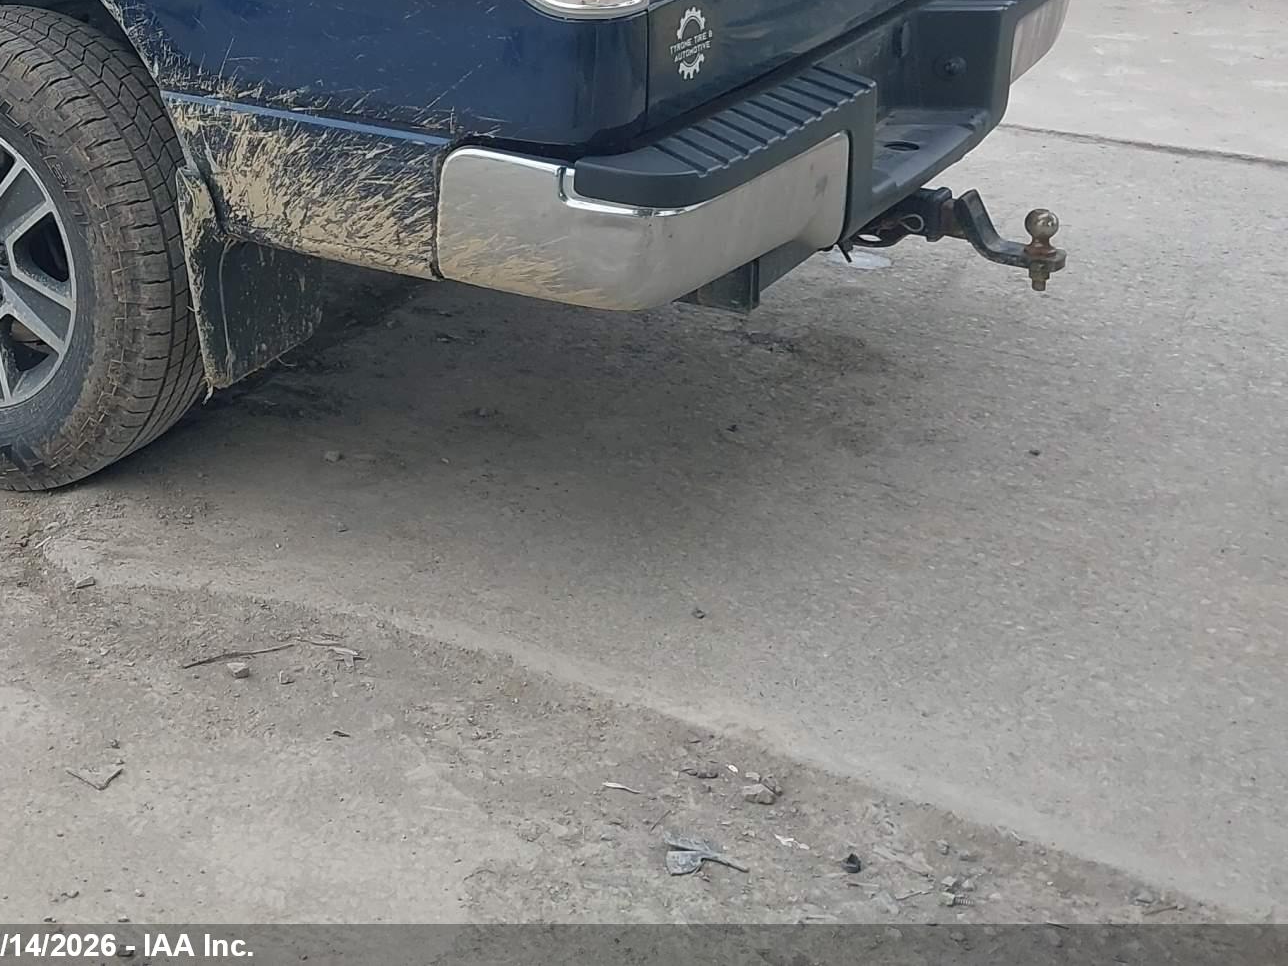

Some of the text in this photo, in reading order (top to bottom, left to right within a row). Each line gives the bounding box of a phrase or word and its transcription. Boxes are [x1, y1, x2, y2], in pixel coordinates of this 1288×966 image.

[669, 37, 693, 54] TYRONE
[694, 31, 708, 44] TIRE
[674, 40, 711, 63] AUTOMOTIVE
